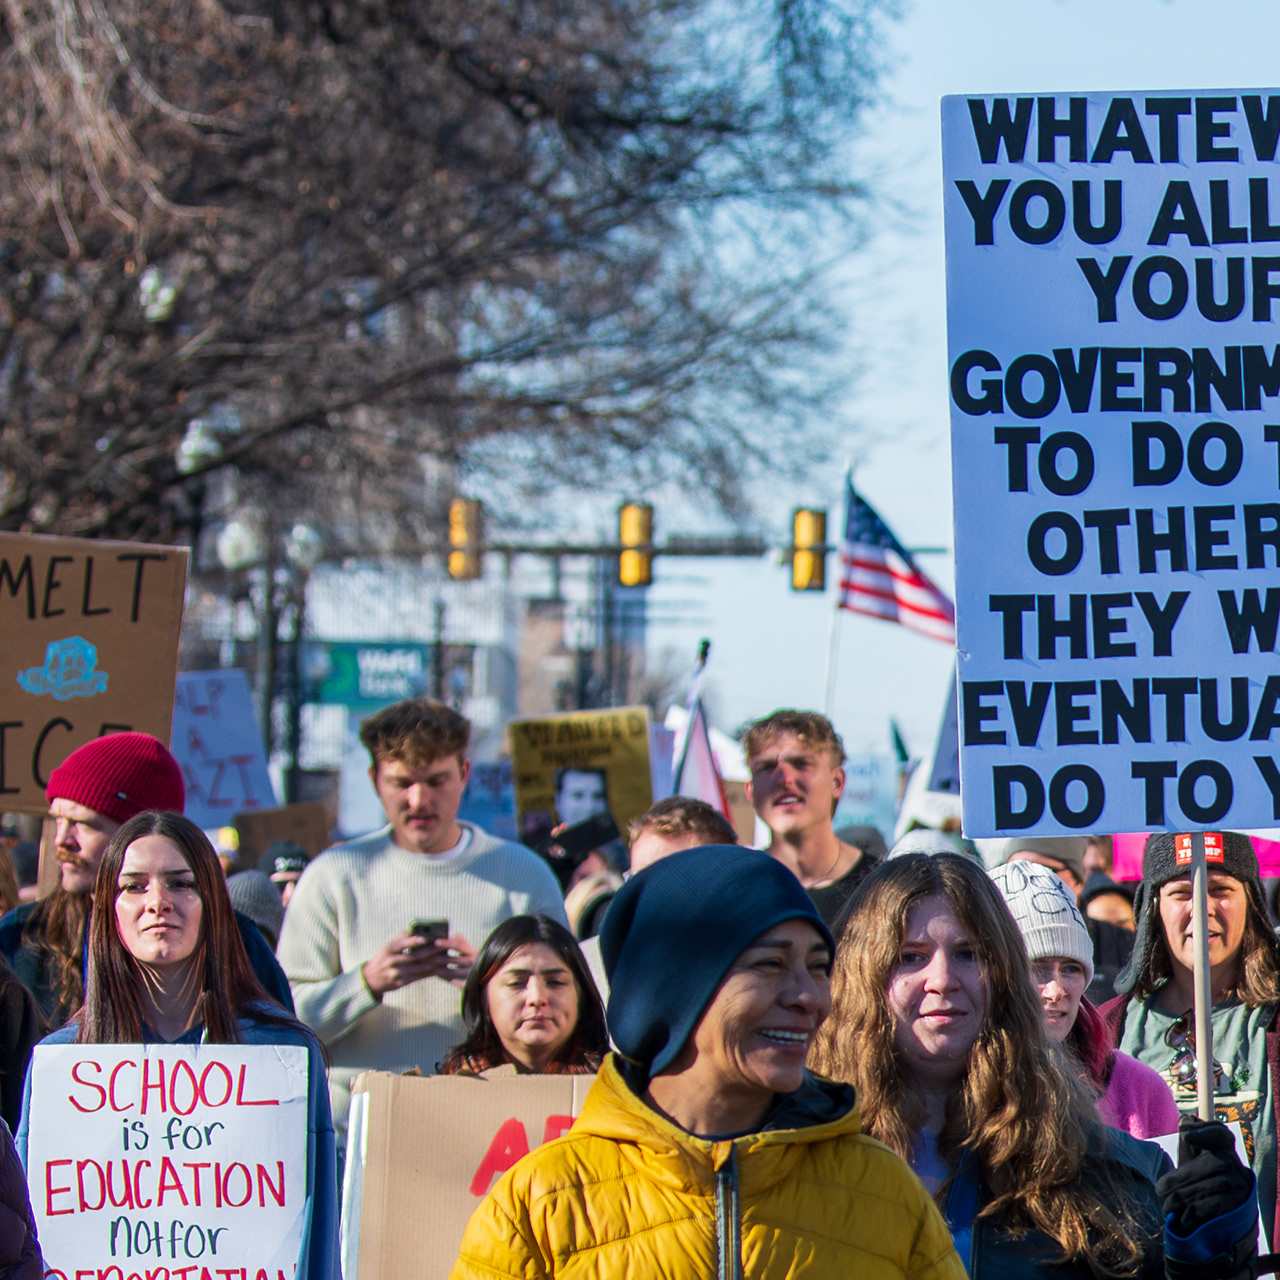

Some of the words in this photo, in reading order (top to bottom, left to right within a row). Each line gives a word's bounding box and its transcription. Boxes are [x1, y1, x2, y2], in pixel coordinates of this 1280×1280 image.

[954, 178, 1123, 246] YOU
[994, 426, 1095, 496] TO
[1131, 421, 1243, 487] DO
[0, 554, 168, 623] MELT
[989, 590, 1191, 660] THEY
[0, 717, 133, 794] IC
[992, 764, 1106, 831] DO
[1131, 759, 1234, 827] TO
[68, 1059, 280, 1115] SCHOOL
[122, 1118, 149, 1151] is
[161, 1117, 225, 1150] for
[45, 1156, 286, 1216] EDUCATION
